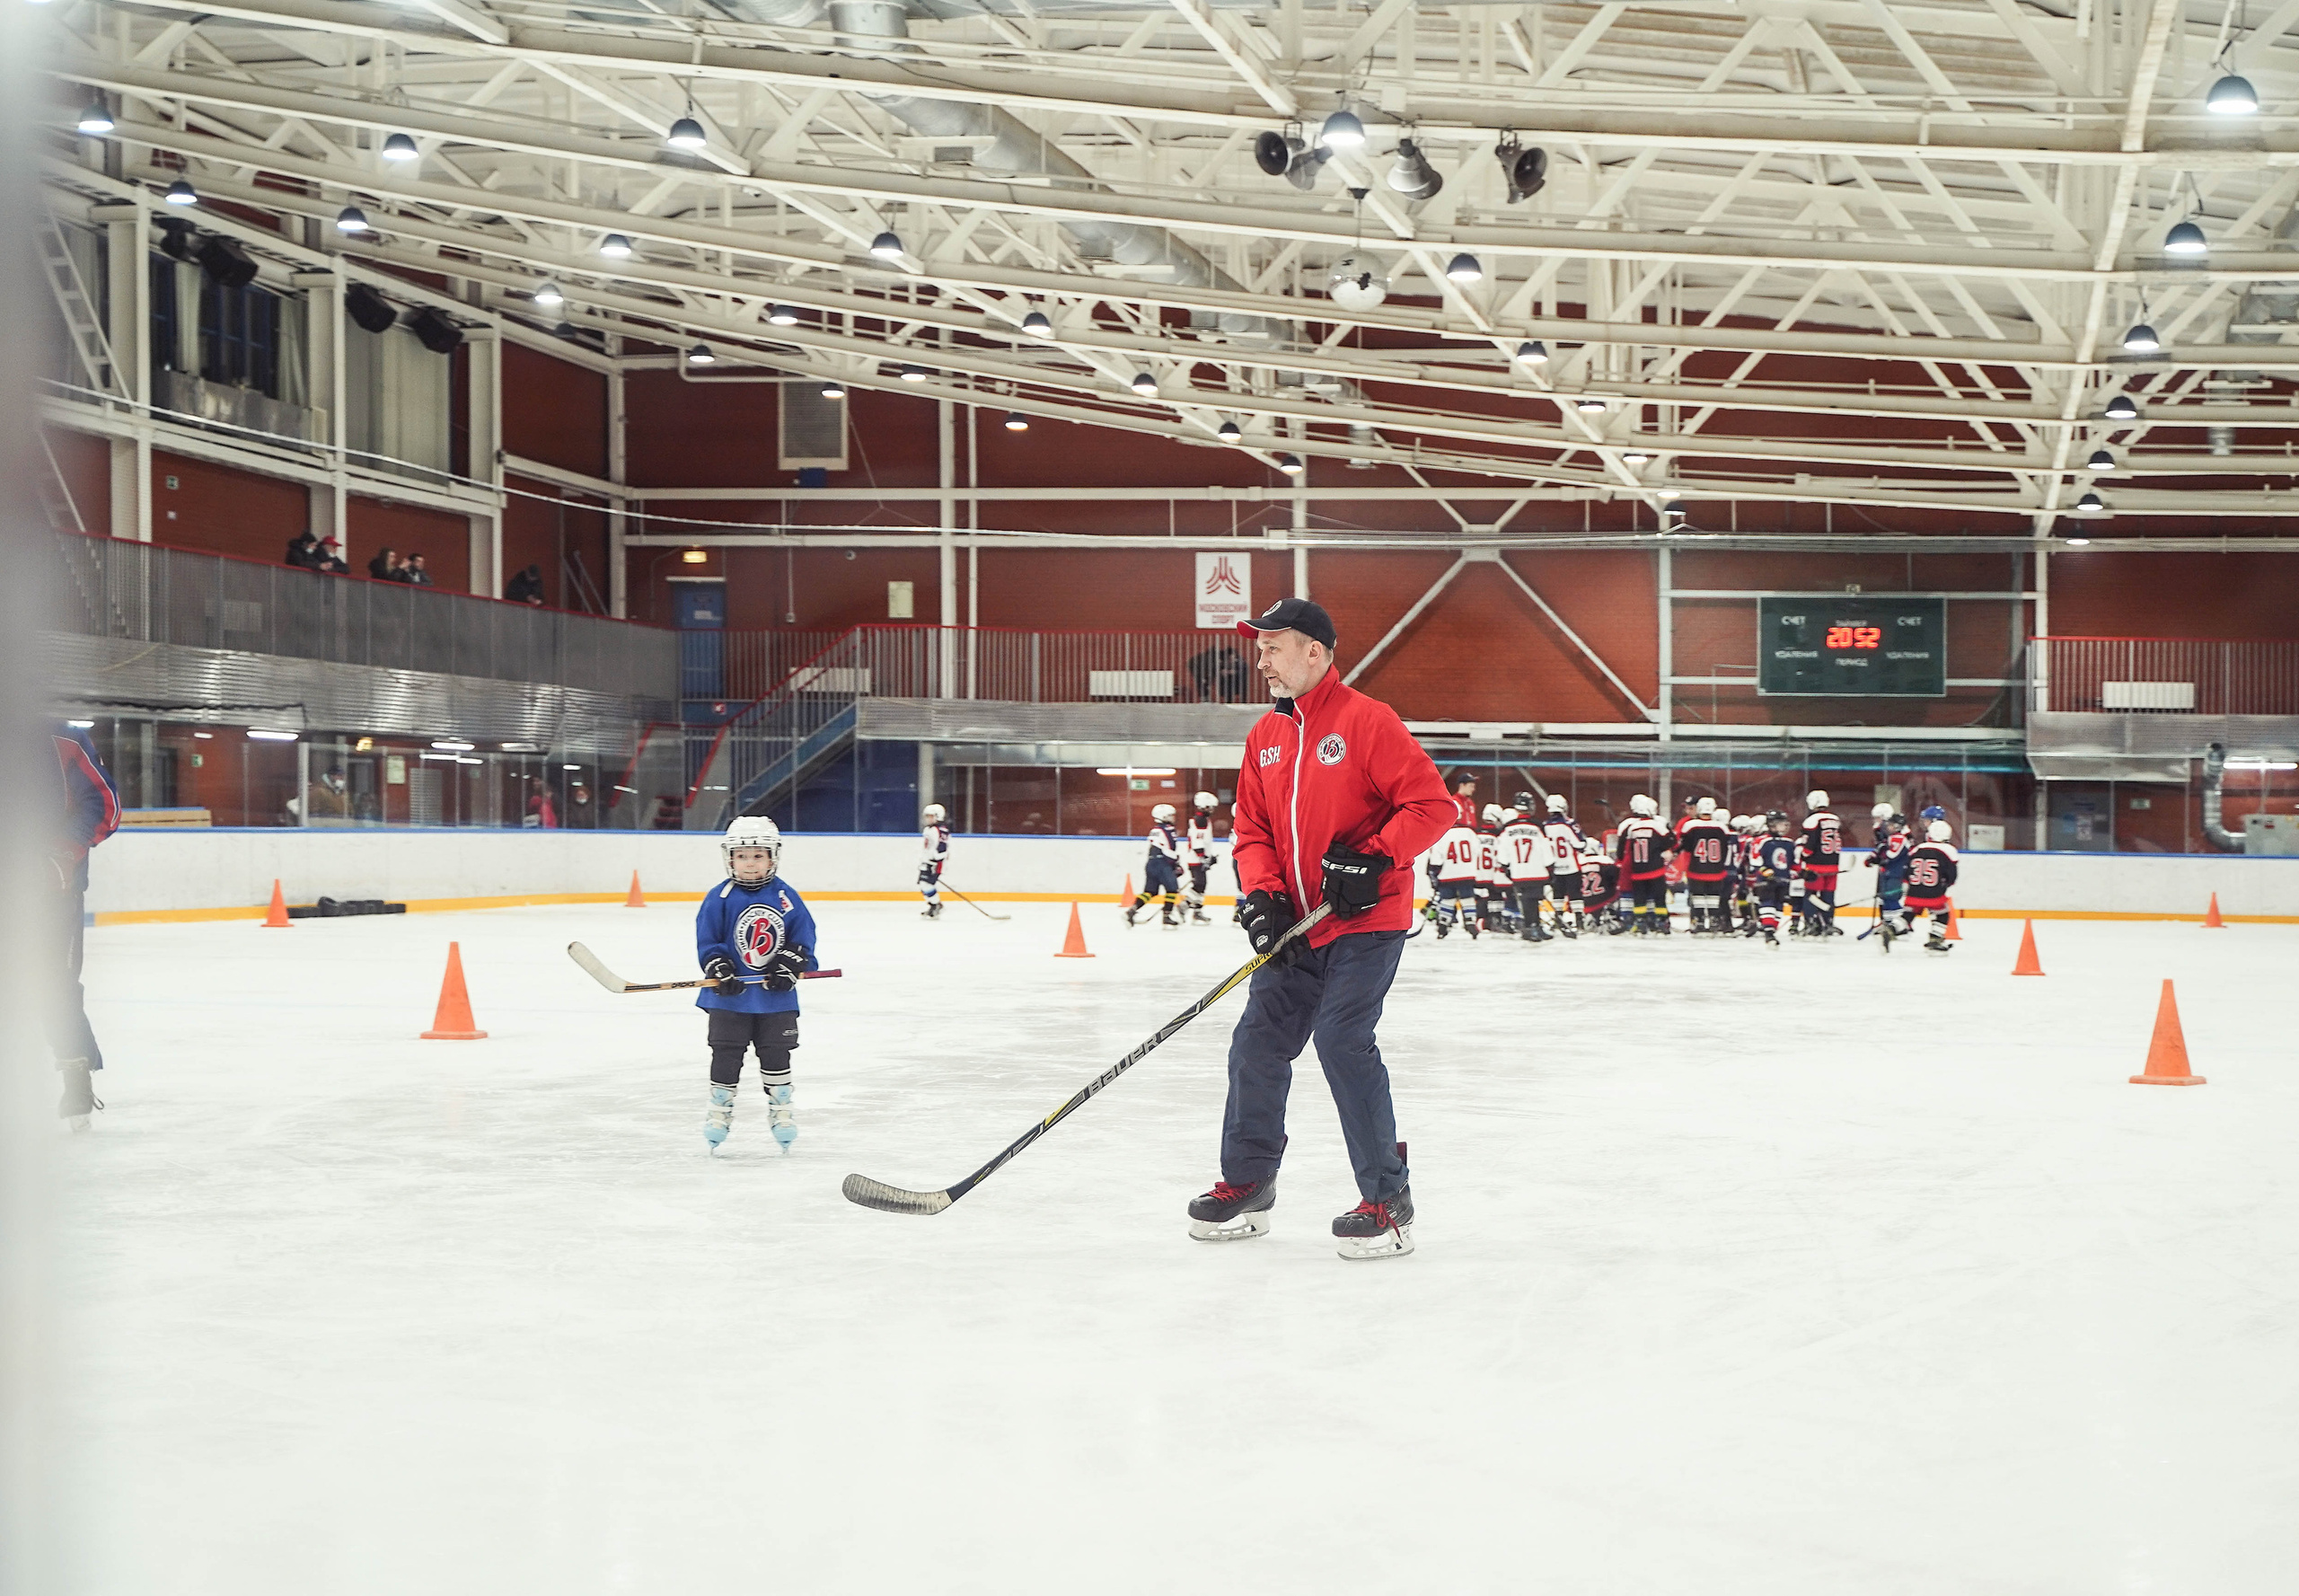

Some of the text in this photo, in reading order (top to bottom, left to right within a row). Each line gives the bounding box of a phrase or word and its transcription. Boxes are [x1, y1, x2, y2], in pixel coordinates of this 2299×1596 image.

[1447, 840, 1472, 864] 40
[1514, 838, 1532, 864] 17
[1634, 839, 1649, 862] 11
[1694, 838, 1722, 863] 40
[1321, 858, 1368, 875] EFSI
[1909, 858, 1940, 886] 35
